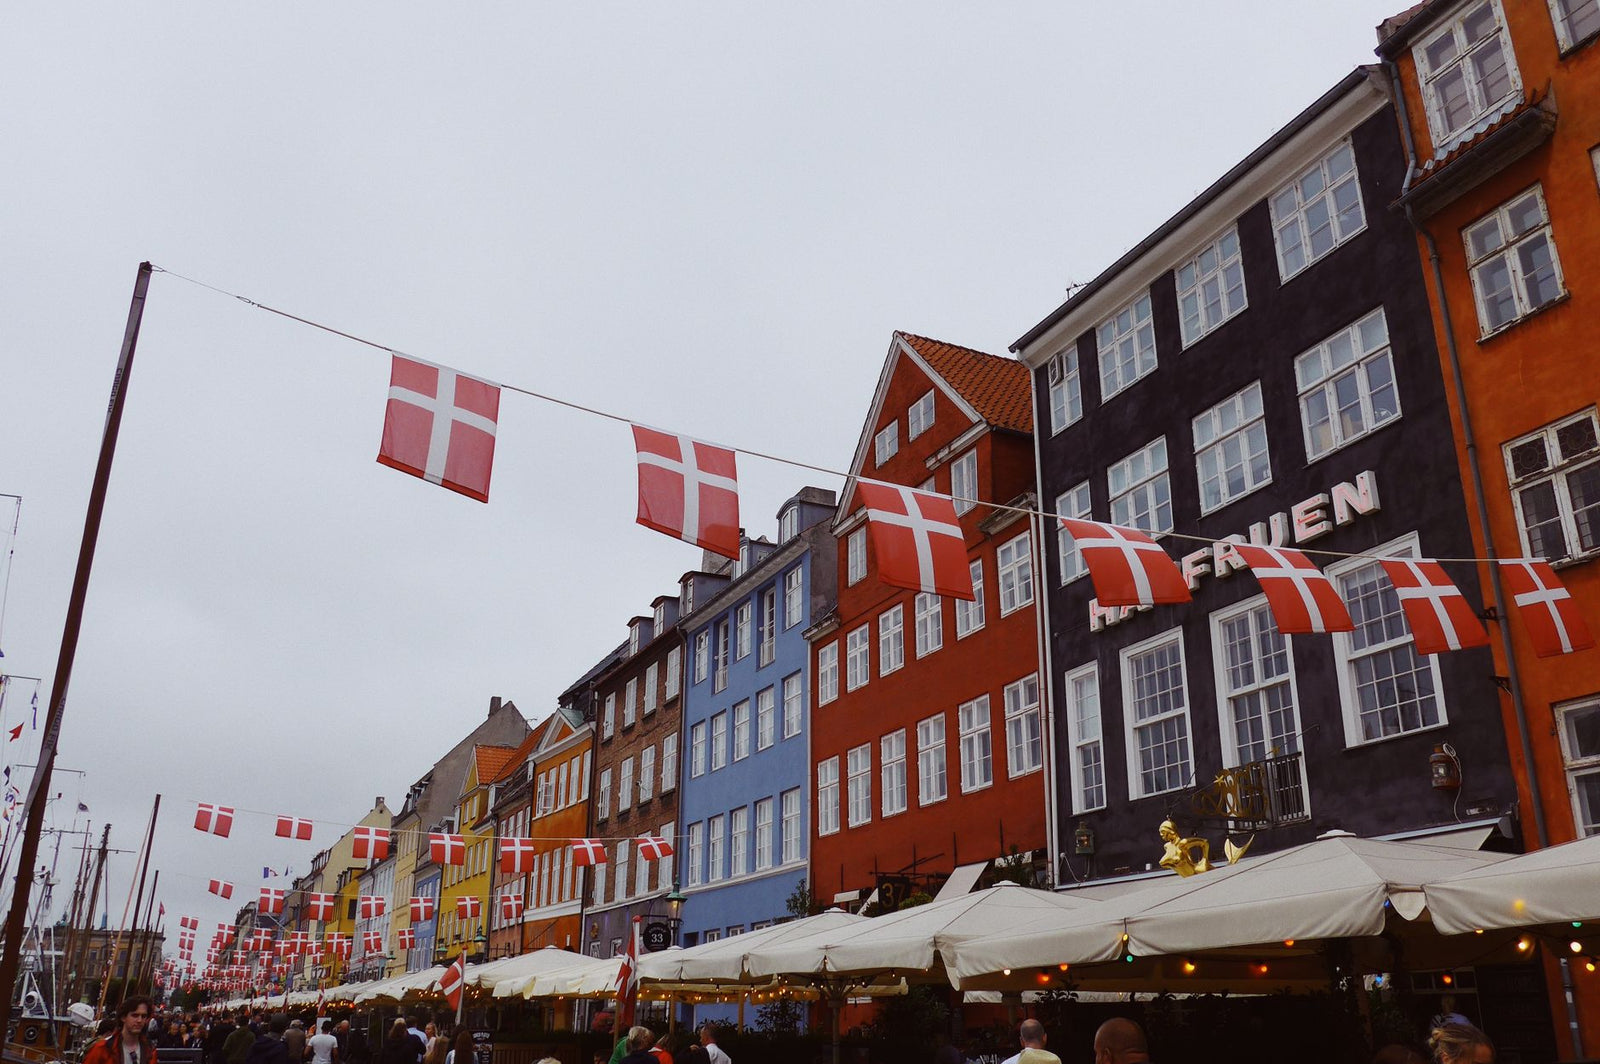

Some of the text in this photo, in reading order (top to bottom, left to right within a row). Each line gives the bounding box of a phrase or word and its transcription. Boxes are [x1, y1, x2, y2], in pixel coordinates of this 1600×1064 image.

[1088, 469, 1381, 632] HFRUEN
[882, 882, 906, 907] 37
[651, 934, 664, 943] 33
